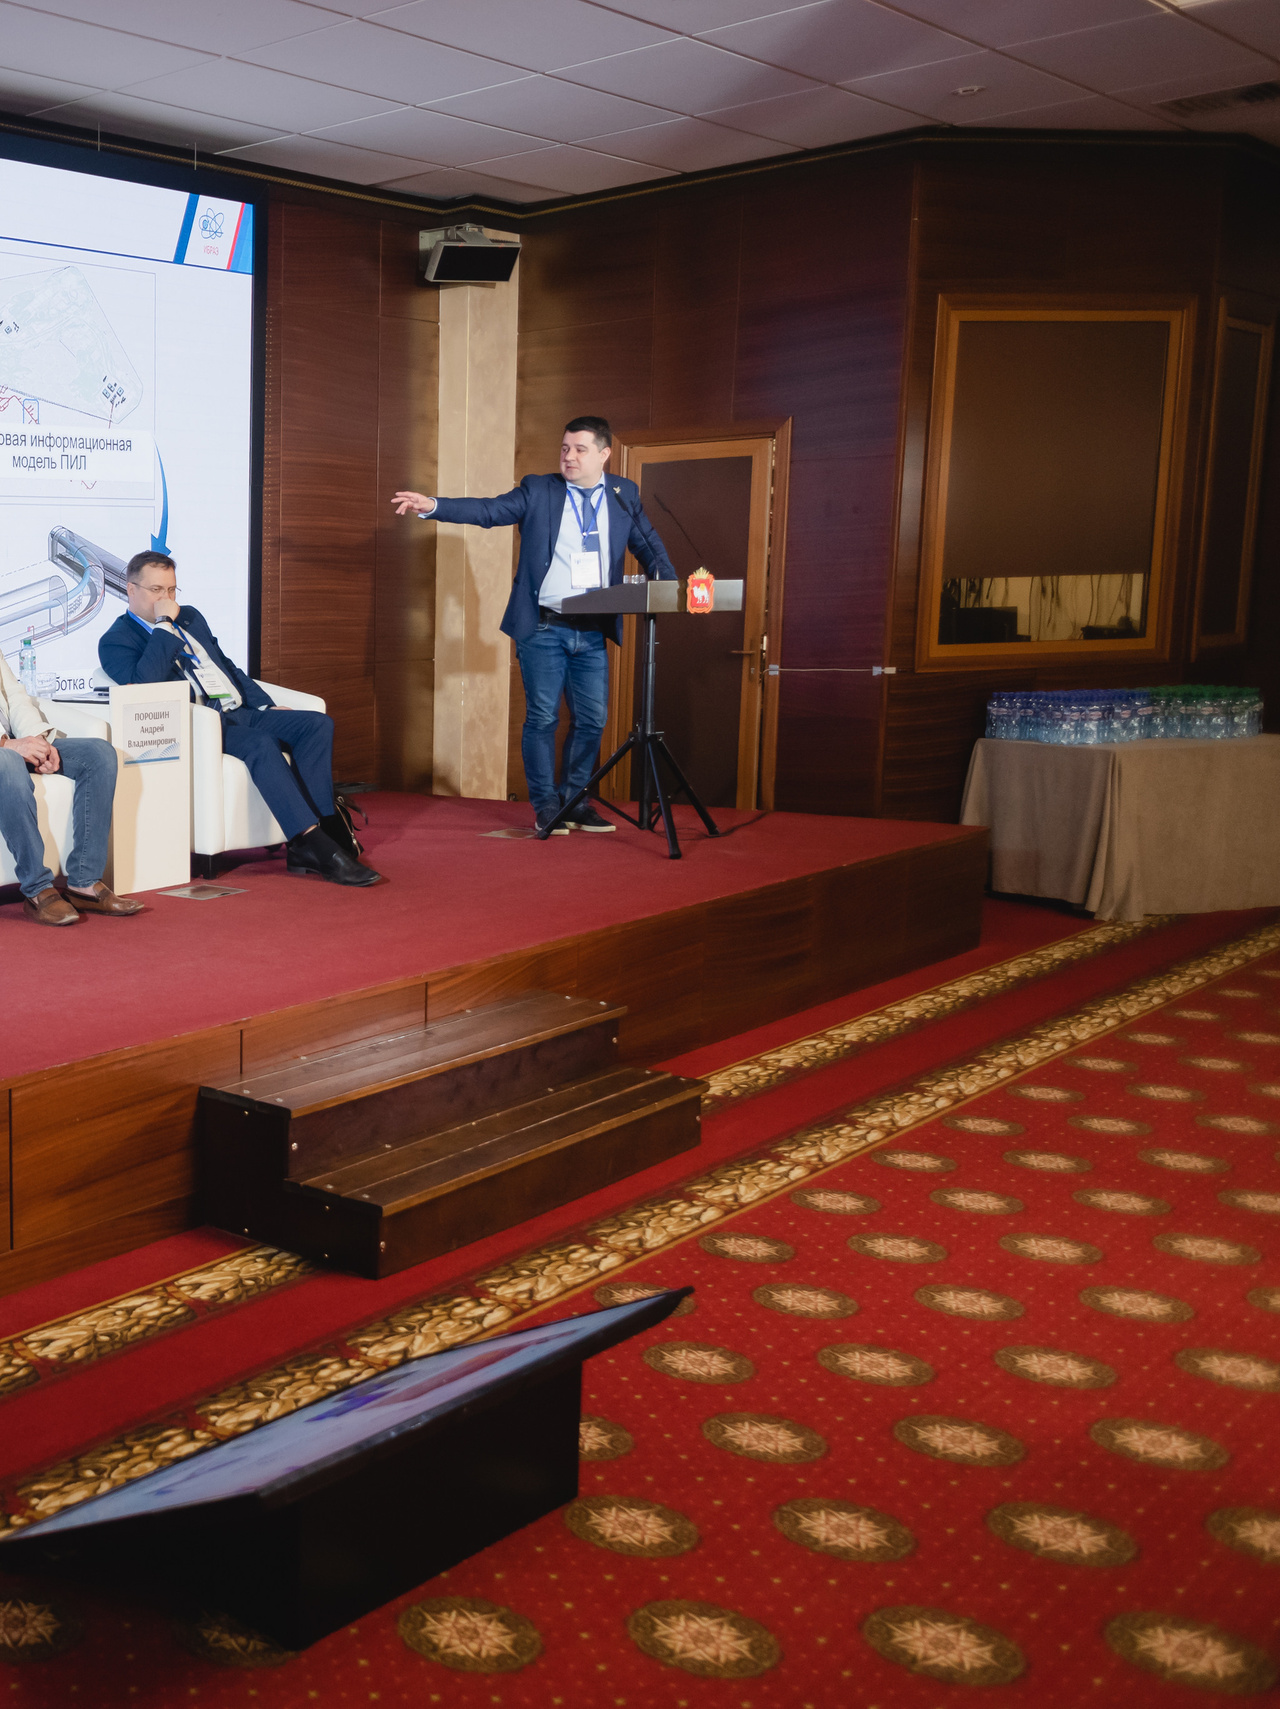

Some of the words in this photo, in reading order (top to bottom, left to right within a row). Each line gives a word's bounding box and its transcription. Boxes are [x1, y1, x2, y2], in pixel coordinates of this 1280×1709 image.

[30, 432, 132, 453] информационная
[12, 454, 57, 471] модель
[60, 455, 87, 471] ПИЛ
[134, 711, 170, 721] ПОРОШИН
[140, 724, 165, 735] Андрей
[127, 737, 177, 749] Владимирович
